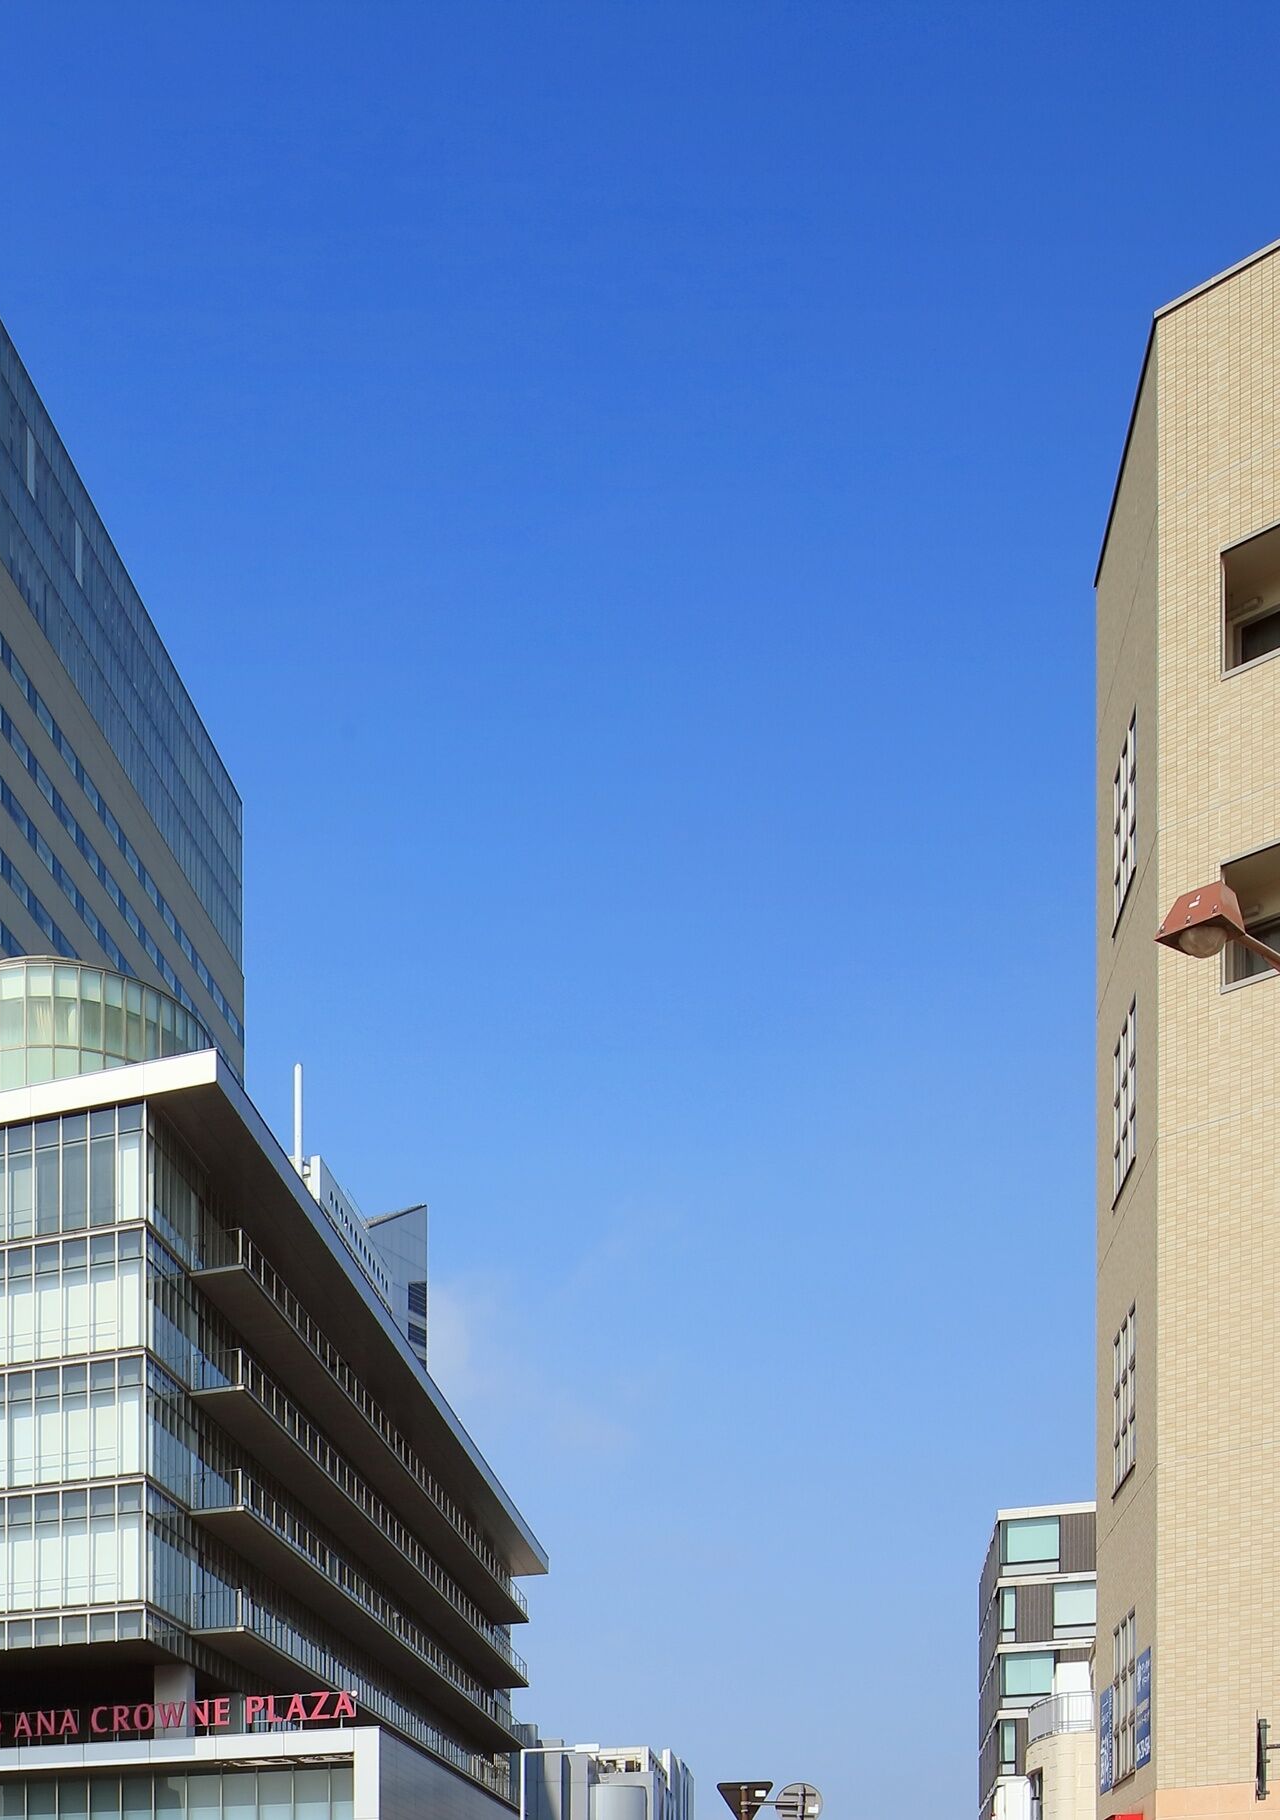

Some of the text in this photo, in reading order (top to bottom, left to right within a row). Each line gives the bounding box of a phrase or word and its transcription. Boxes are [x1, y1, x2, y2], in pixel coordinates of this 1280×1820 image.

[13, 1690, 357, 1739] ANA CROWNE PLAZA
